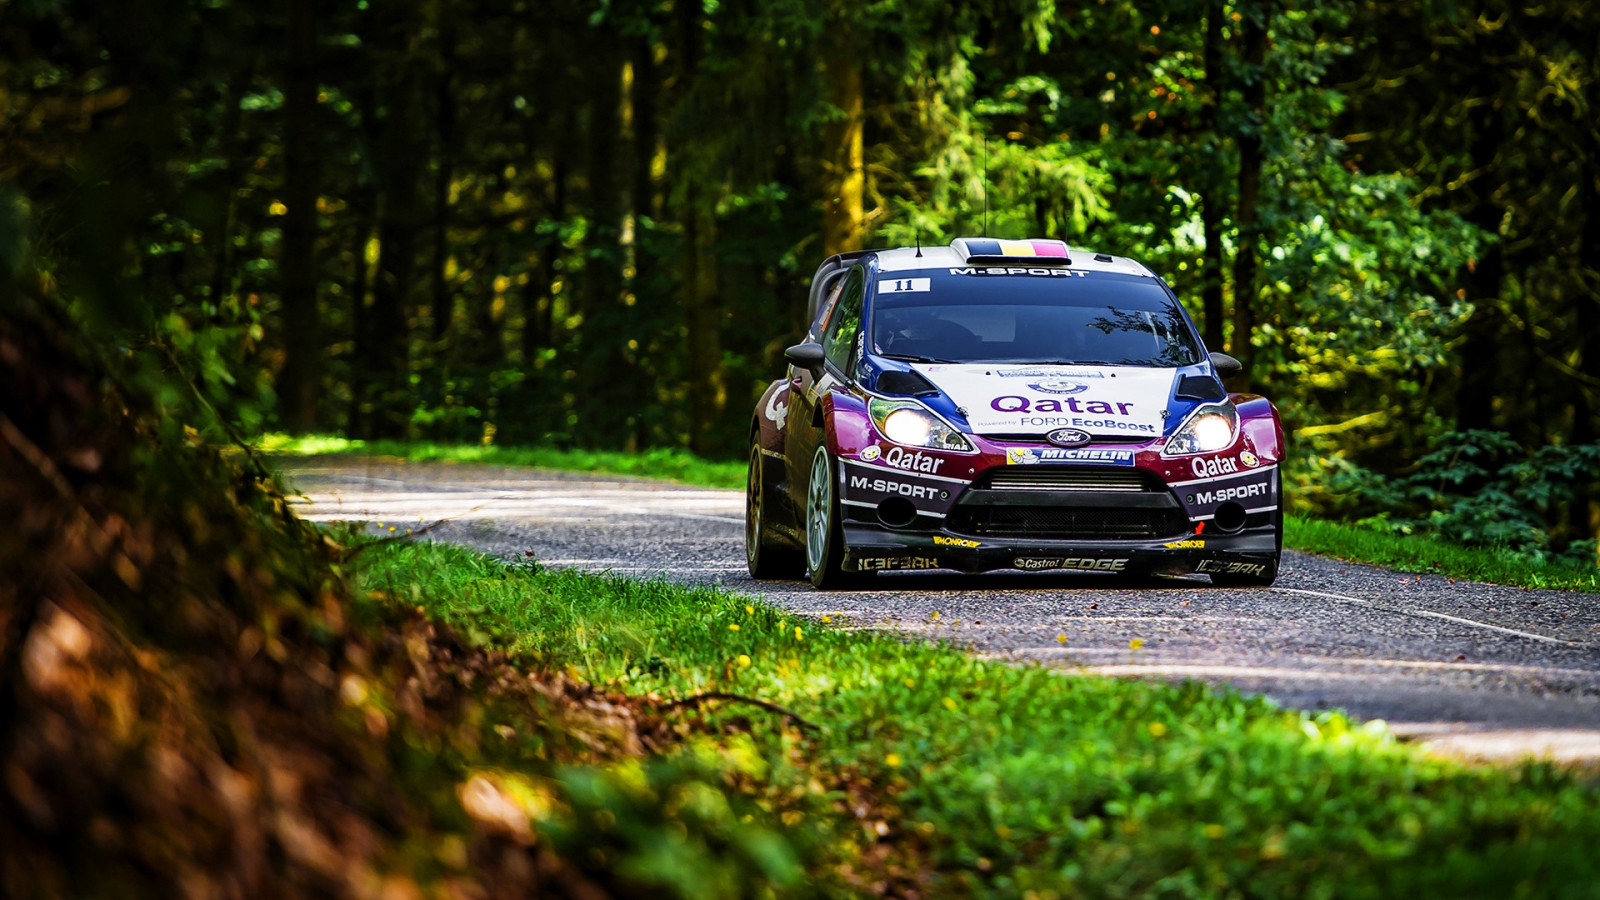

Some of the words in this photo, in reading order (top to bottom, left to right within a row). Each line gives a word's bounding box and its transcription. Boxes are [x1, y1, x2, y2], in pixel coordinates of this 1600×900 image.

[950, 267, 1090, 278] M-SPORT
[894, 280, 914, 291] 11
[990, 395, 1134, 416] Qatar
[1021, 417, 1069, 426] FORD
[1072, 418, 1155, 433] EcoBoost
[1055, 431, 1082, 443] Ford
[885, 446, 945, 474] Qatar
[1040, 449, 1131, 461] MICHELIN
[1191, 454, 1239, 478] Qatar
[850, 475, 939, 500] M-SPORT
[1196, 482, 1268, 505] M-SPORT
[1025, 558, 1058, 569] Castrol
[1061, 558, 1129, 571] EDGE
